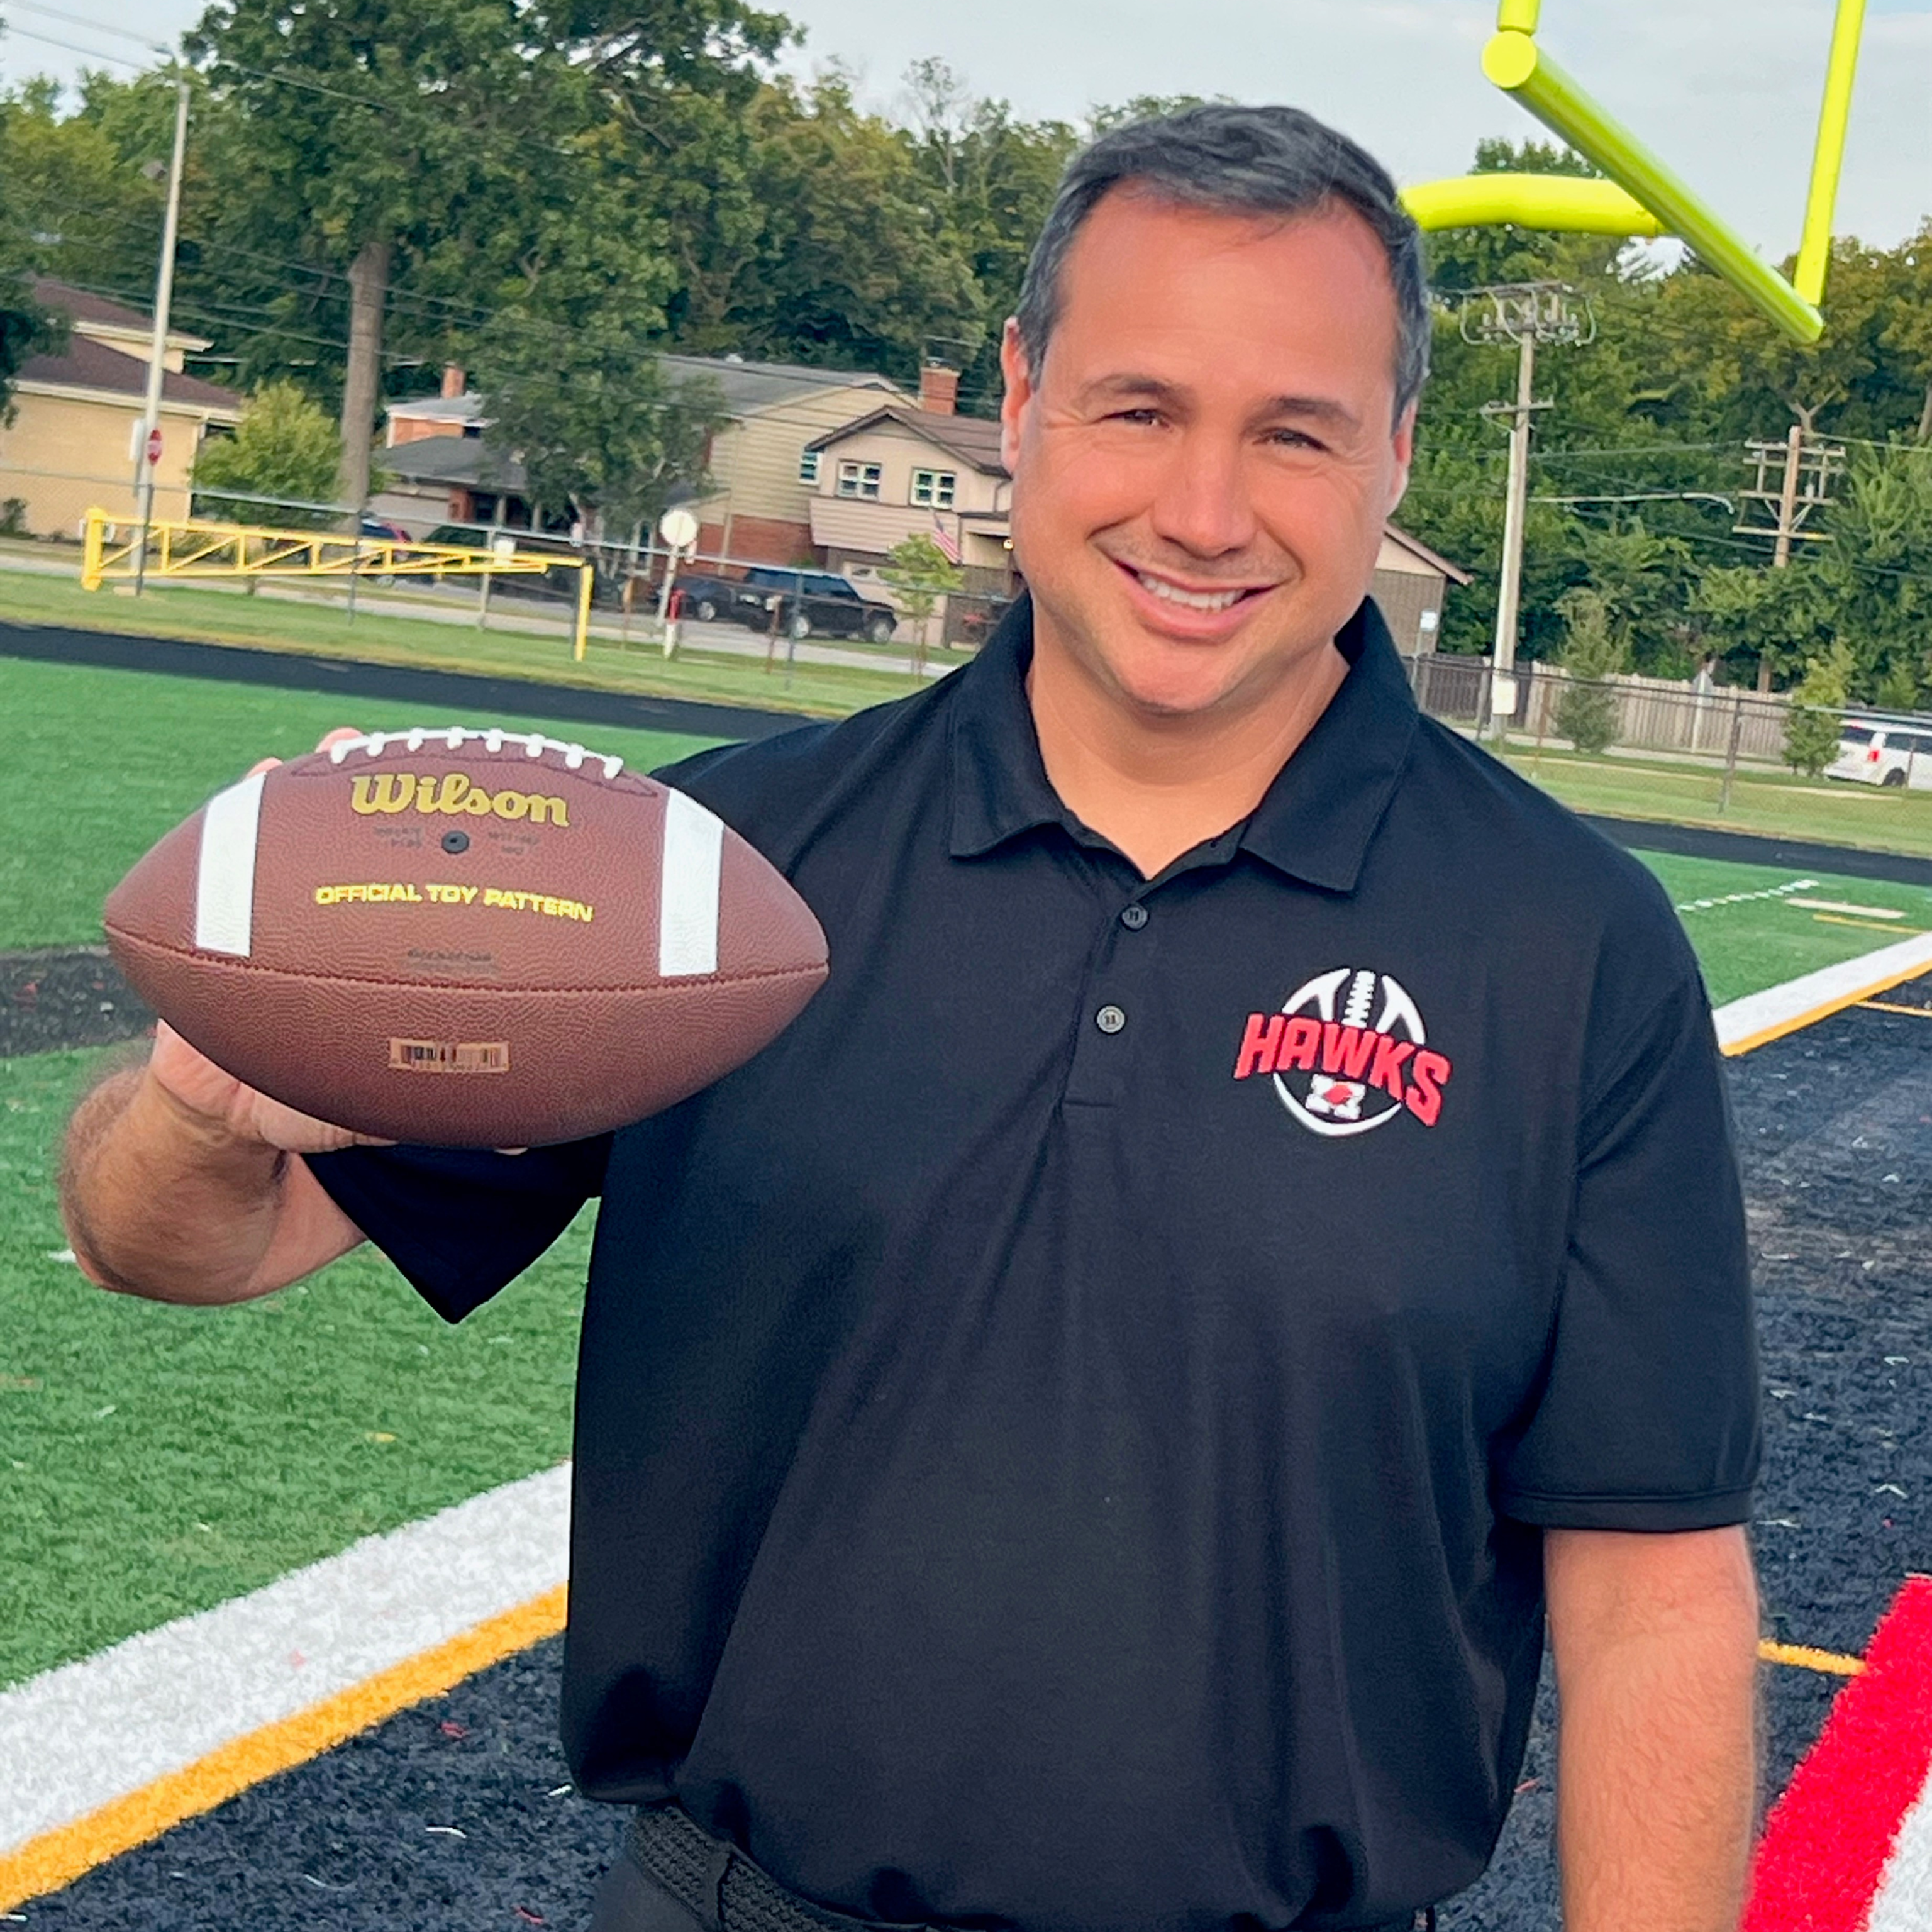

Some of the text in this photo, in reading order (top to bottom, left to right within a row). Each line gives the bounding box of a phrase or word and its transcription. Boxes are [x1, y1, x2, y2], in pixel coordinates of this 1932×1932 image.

[351, 773, 570, 827] Wilson
[315, 882, 594, 923] OFFICIAL TOY PATTERN
[1233, 1011, 1452, 1127] HAWKS
